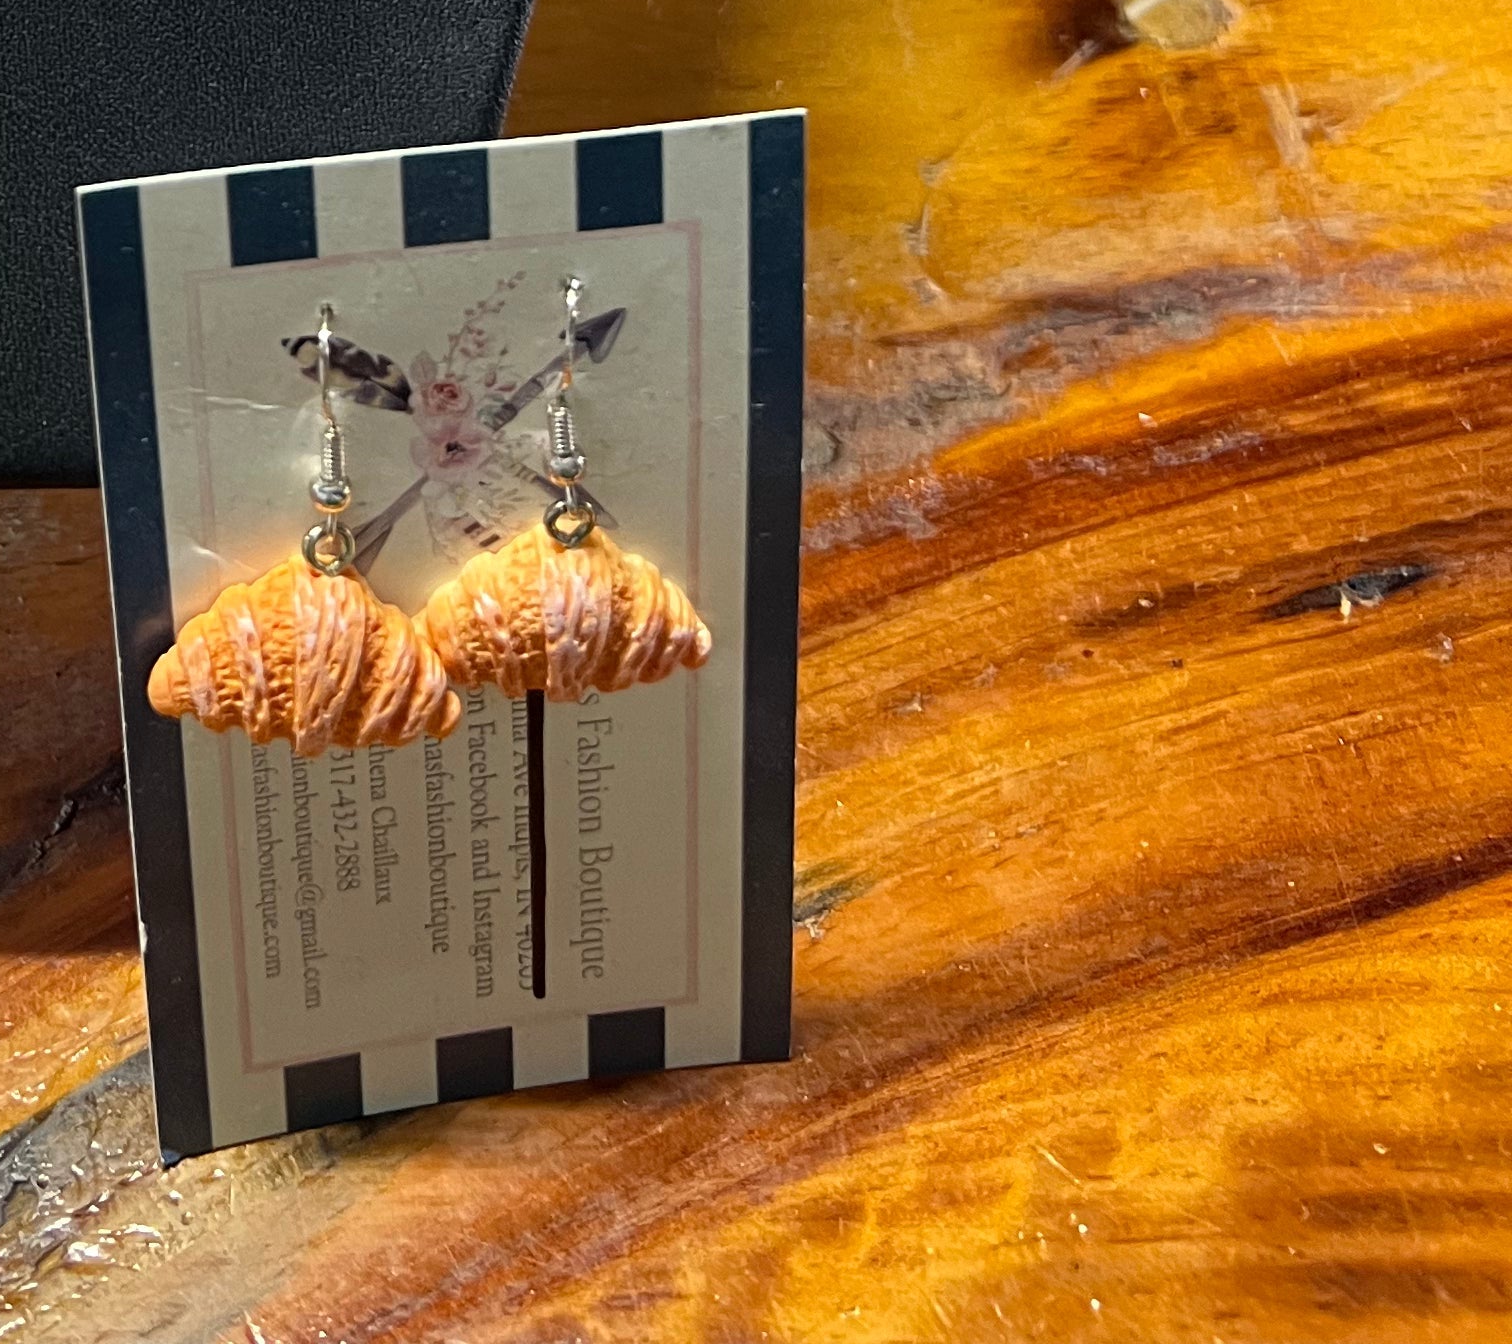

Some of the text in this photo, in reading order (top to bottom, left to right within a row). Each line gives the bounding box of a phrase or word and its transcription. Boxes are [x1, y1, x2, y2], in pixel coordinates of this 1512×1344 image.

[368, 741, 395, 802] thena
[468, 720, 498, 834] Facebook
[576, 716, 615, 834] Fashion
[251, 742, 284, 980] asfashionboutique.com
[290, 753, 328, 1010] ionboutique@gmail.com
[424, 734, 457, 954] nasfashionboutique
[471, 837, 501, 883] and
[468, 887, 501, 999] Instagram
[569, 843, 615, 980] Boutique
